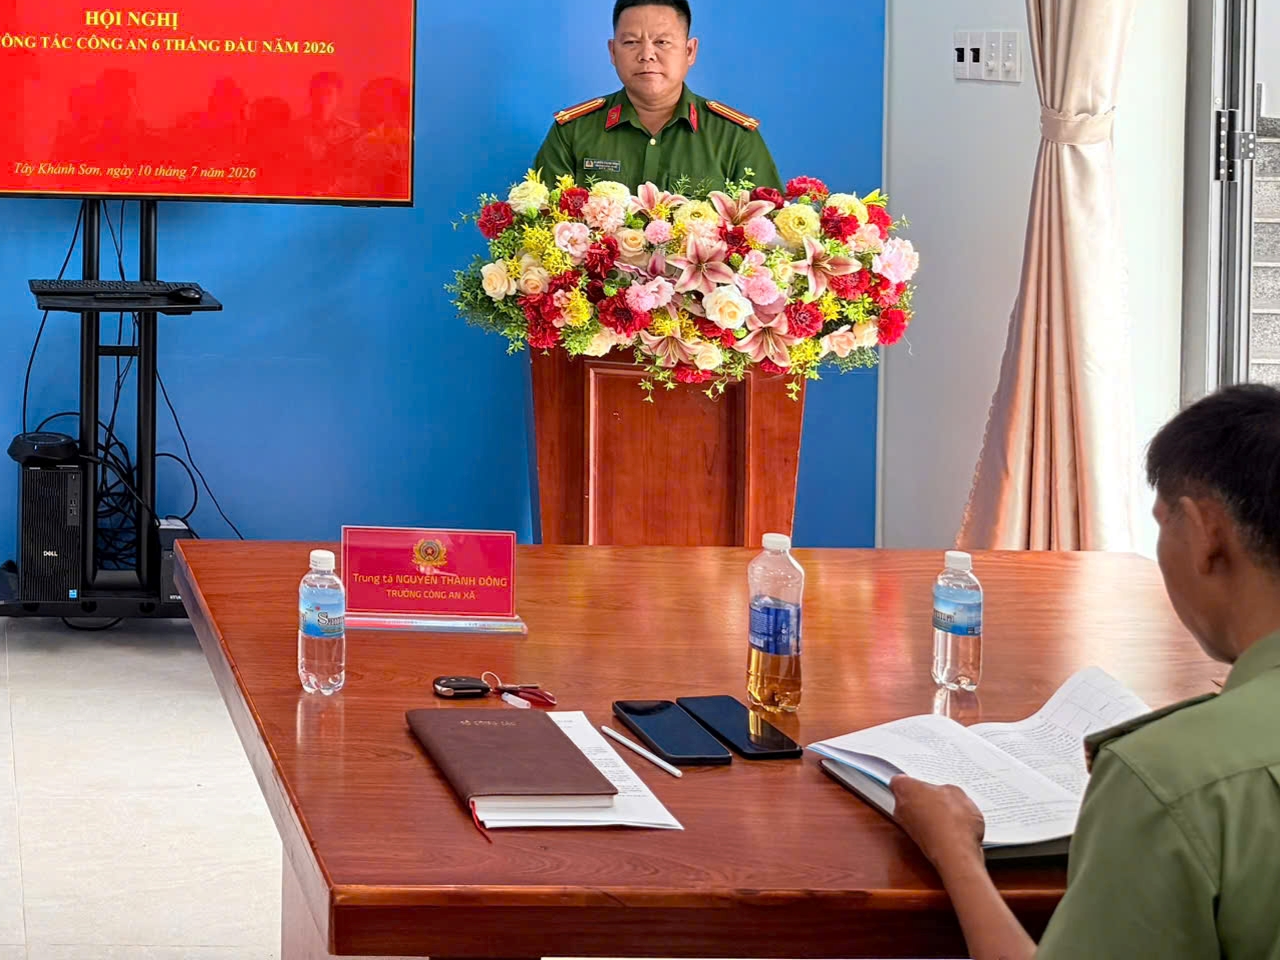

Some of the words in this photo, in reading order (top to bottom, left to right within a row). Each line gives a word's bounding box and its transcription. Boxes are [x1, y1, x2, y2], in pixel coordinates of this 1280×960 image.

[85, 8, 121, 29] HỘI
[127, 11, 178, 30] NGHỊ
[40, 33, 72, 49] TÁC
[76, 34, 123, 49] CÔNG
[126, 38, 148, 50] AN
[152, 39, 160, 51] 6
[163, 35, 220, 52] THÁNG
[262, 37, 299, 53] NĂM
[303, 41, 335, 54] 2026
[14, 162, 35, 176] Tây
[38, 162, 75, 175] Khánh
[106, 164, 134, 178] ngày
[138, 165, 152, 176] 10
[154, 165, 187, 180] tháng
[191, 166, 198, 177] 7
[200, 167, 224, 178] năm
[227, 167, 257, 178] 2026
[353, 573, 380, 585] Trung
[448, 591, 461, 599] AN
